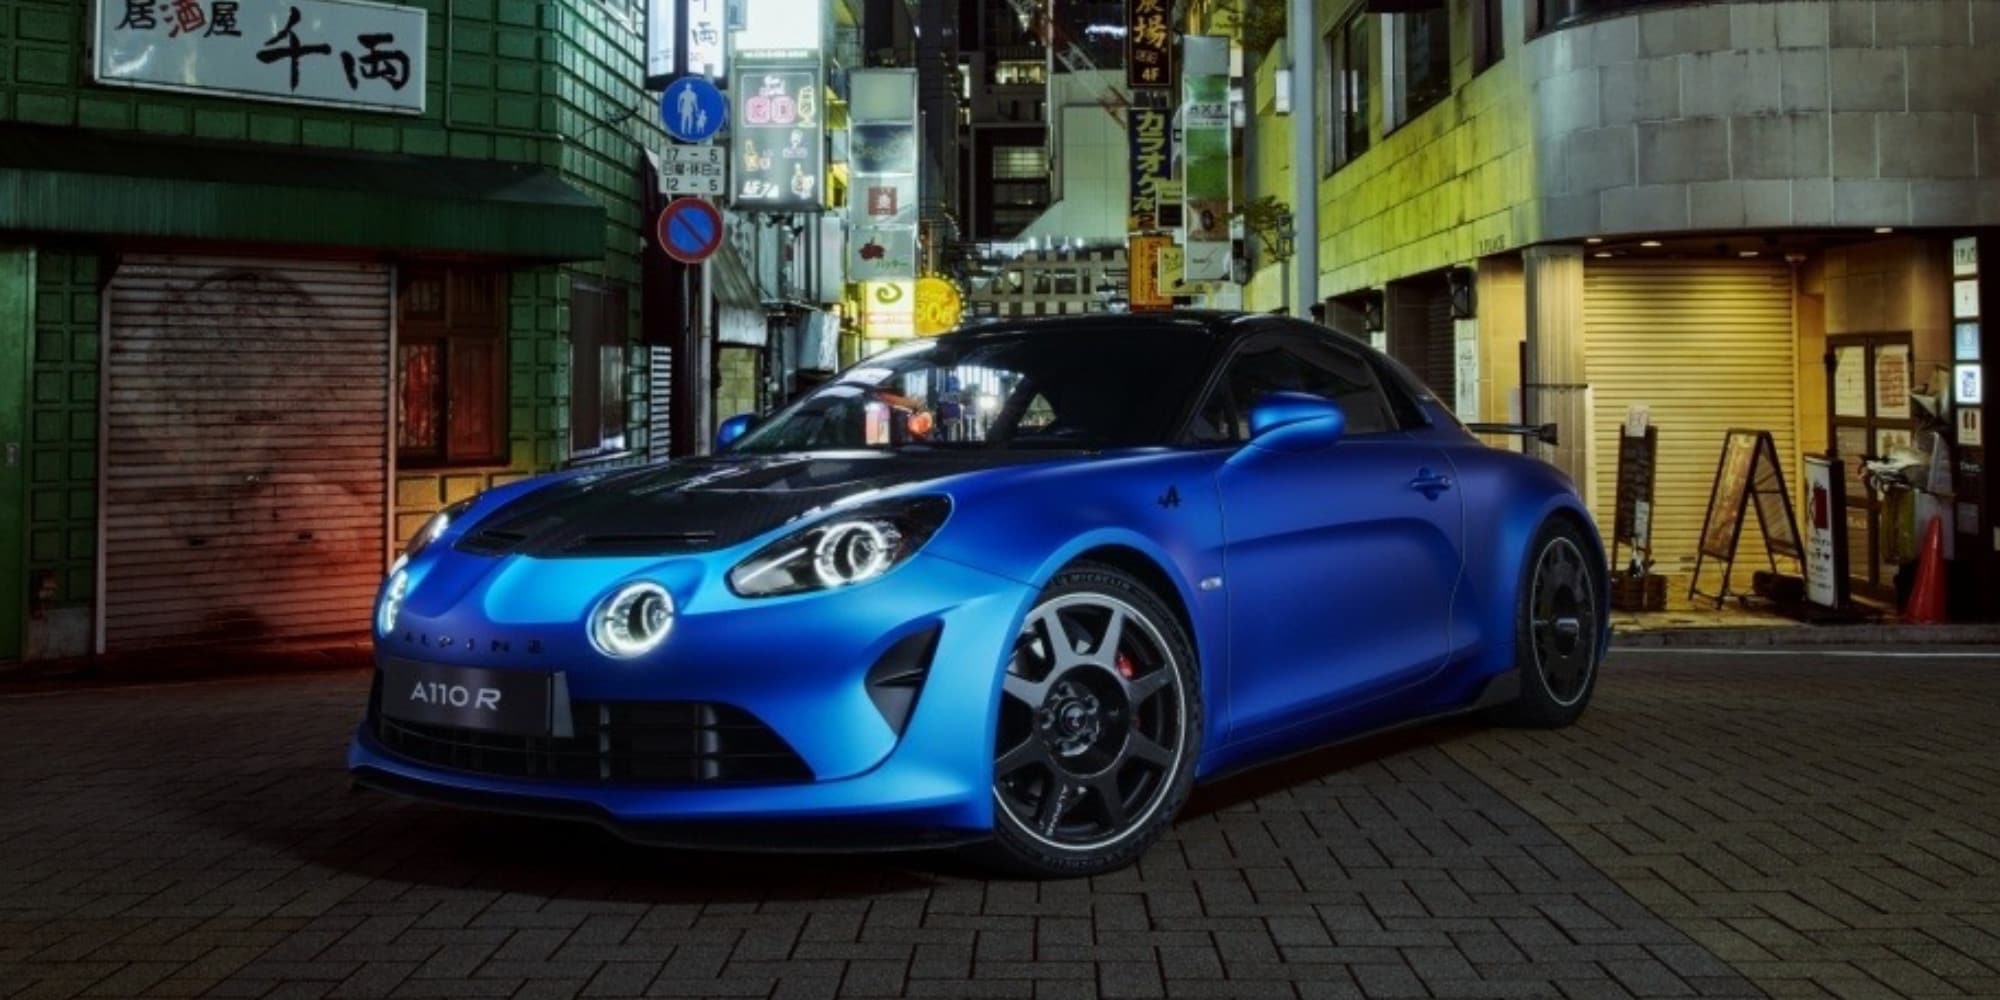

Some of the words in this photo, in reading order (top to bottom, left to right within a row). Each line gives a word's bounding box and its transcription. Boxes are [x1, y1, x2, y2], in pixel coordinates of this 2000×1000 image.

[115, 0, 242, 38] 居酒屋
[255, 6, 411, 91] 千両
[665, 149, 680, 161] 17
[709, 150, 718, 161] 5
[666, 178, 679, 191] 12
[709, 179, 718, 191] 5
[410, 681, 469, 707] A110
[474, 688, 502, 711] R
